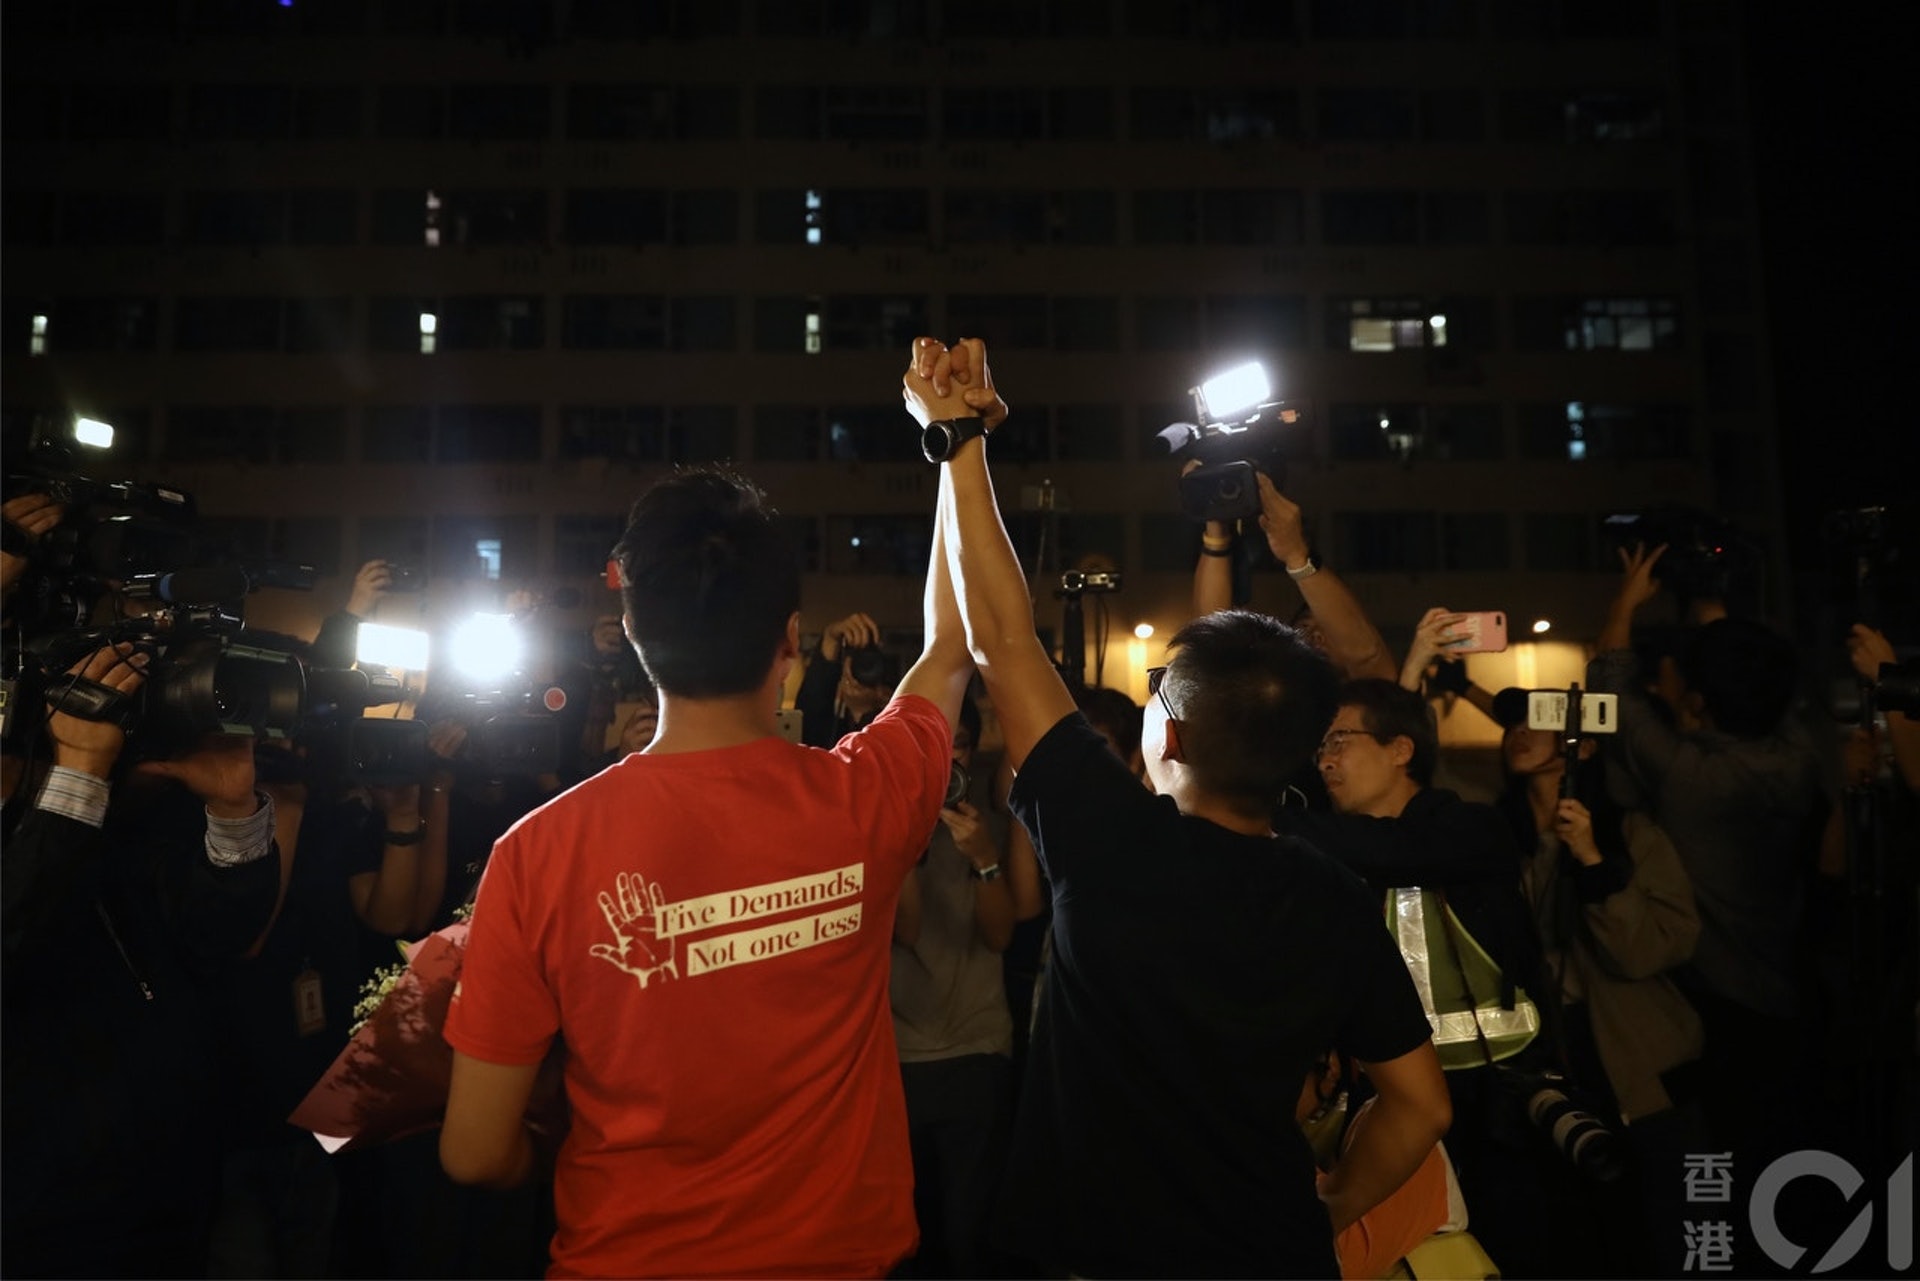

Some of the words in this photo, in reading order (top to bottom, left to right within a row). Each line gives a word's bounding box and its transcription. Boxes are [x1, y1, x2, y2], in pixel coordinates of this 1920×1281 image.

[660, 904, 716, 934] Five
[728, 871, 862, 919] Demands,
[691, 939, 736, 972] Not
[749, 930, 801, 957] one
[812, 911, 859, 941] less
